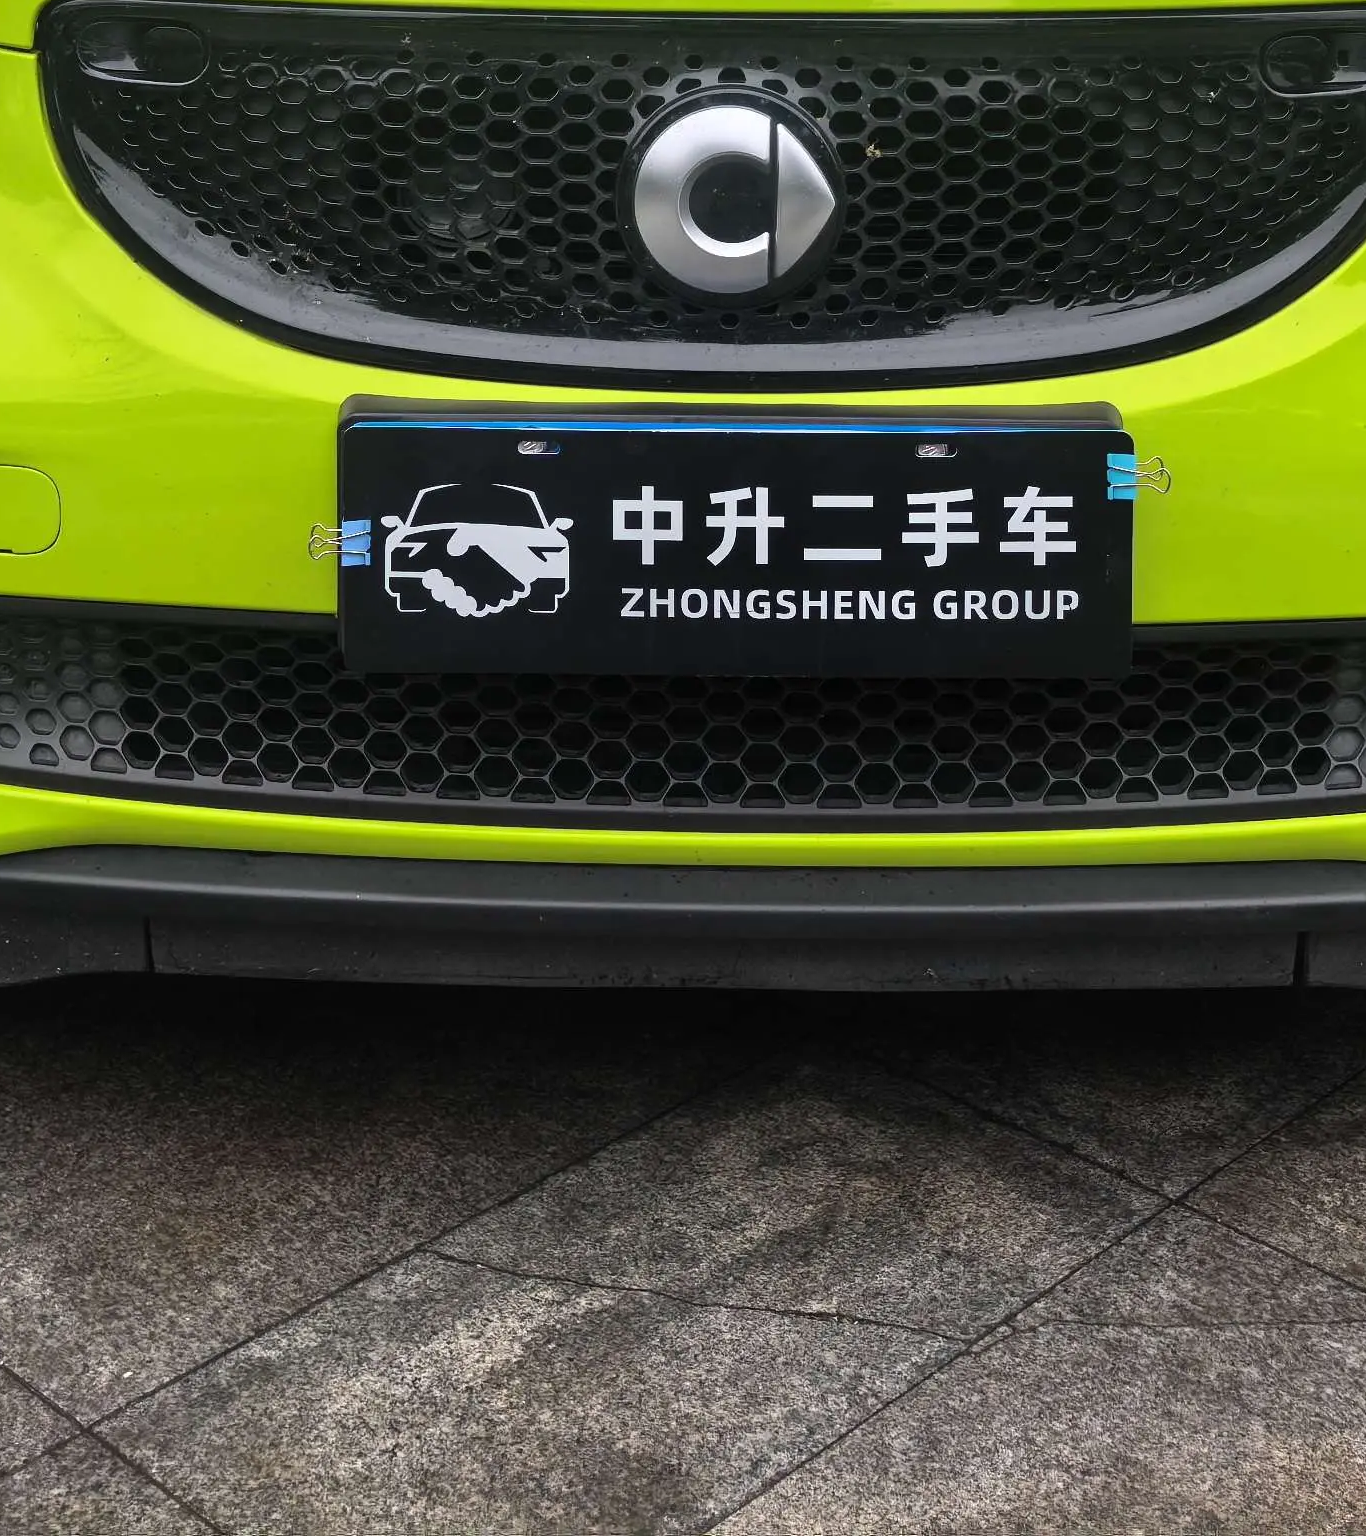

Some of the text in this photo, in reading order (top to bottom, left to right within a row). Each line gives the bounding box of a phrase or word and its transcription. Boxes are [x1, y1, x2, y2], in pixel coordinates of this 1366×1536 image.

[613, 486, 1077, 567] 中升二手车
[620, 588, 1079, 620] ZHONGSHENG GROUP
